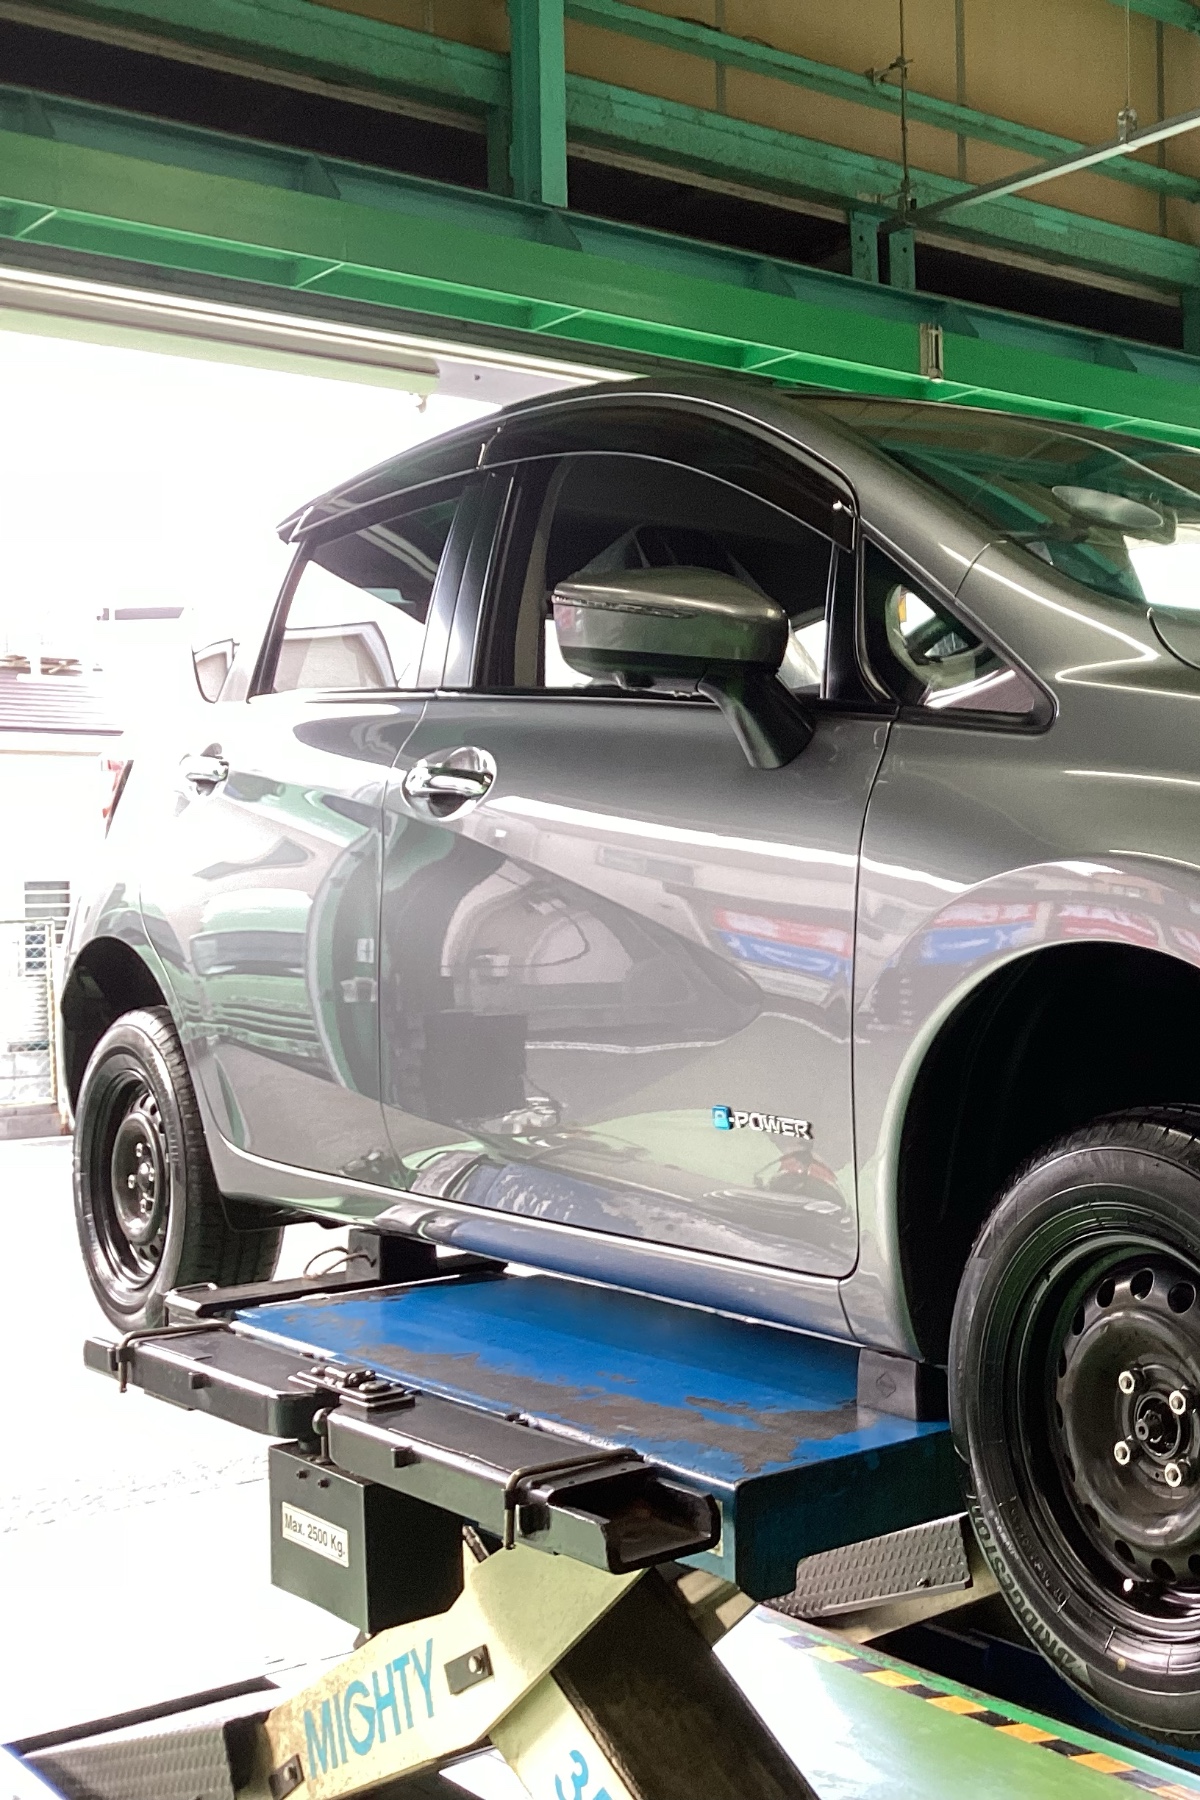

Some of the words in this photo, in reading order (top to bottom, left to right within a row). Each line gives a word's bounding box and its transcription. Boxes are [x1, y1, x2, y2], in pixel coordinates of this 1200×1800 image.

[285, 1512, 306, 1536] Max.
[307, 1523, 328, 1547] 2500
[330, 1533, 346, 1558] Kg.
[303, 1637, 434, 1780] MIGHTY
